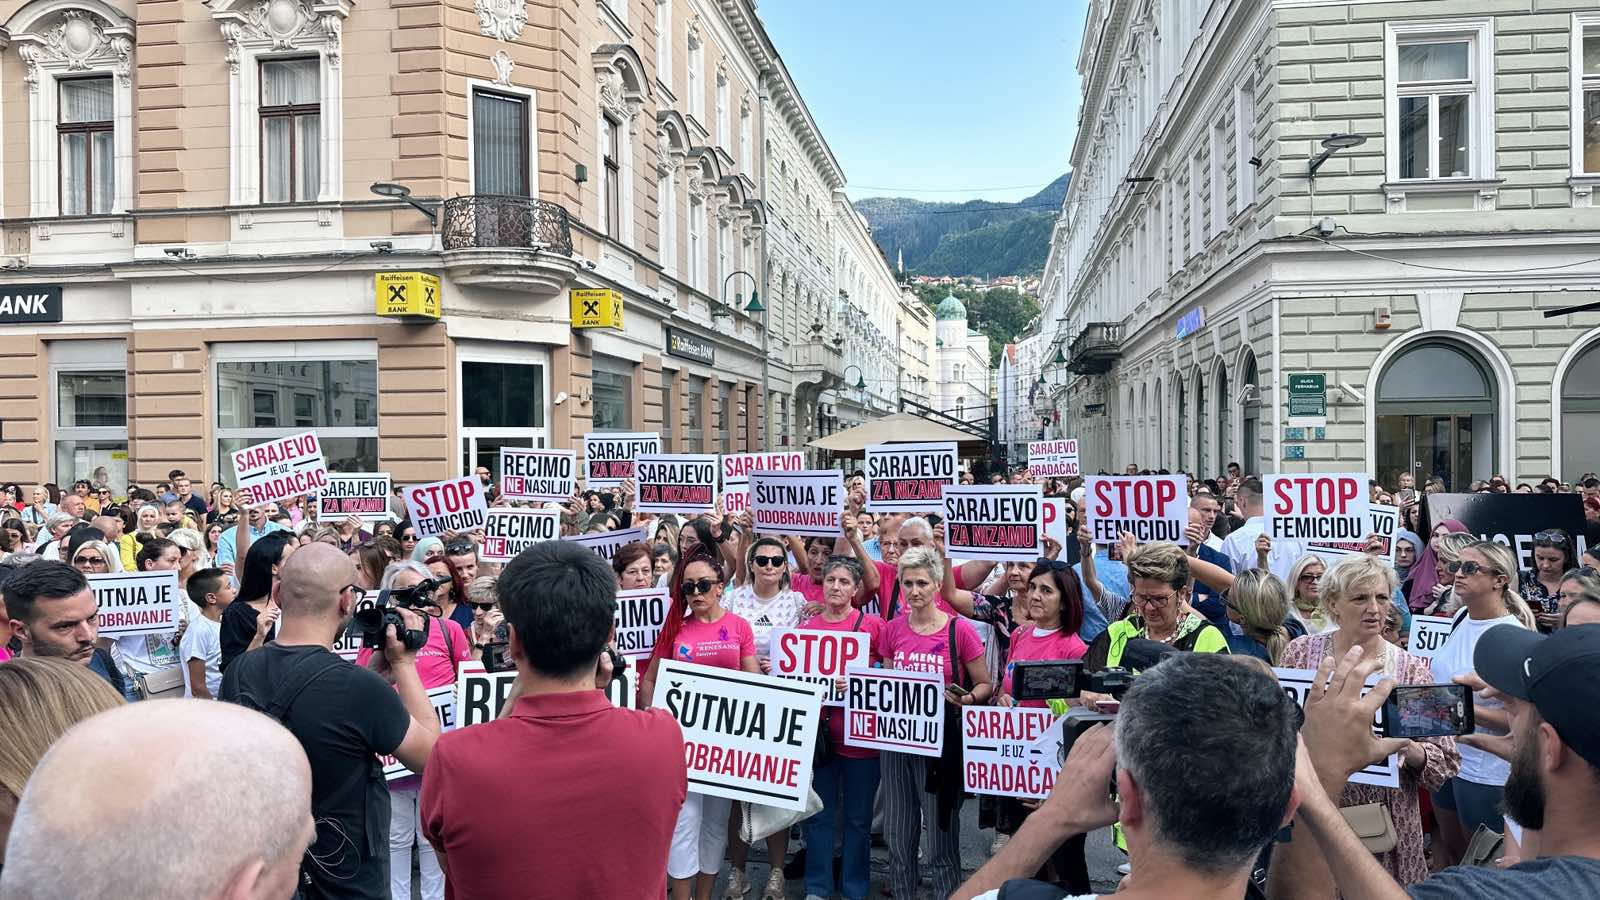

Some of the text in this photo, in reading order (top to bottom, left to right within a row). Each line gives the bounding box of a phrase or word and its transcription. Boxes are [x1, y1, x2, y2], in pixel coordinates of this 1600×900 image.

[235, 435, 317, 472] SARAJEVO
[587, 441, 657, 461] SARAJEVO
[1029, 440, 1076, 456] SARAJEVO
[270, 463, 290, 477] JE UZ
[503, 455, 571, 479] RECIMO
[591, 462, 607, 477] ZA
[637, 464, 714, 484] SARAJEVO
[868, 453, 953, 478] SARAJEVO
[1029, 460, 1078, 476] GRADAČAC
[505, 477, 571, 496] NE NASILJU
[642, 486, 659, 502] ZA
[661, 486, 711, 504] NIZAMU
[756, 480, 815, 506] ŠUTNJA
[820, 485, 837, 506] JE
[873, 481, 892, 499] ZA
[1274, 477, 1358, 516] STOP
[324, 498, 384, 513] ZA NIZAMU
[412, 480, 475, 518] STOP
[946, 497, 1037, 522] SARAJEVO
[1094, 479, 1177, 518] STOP
[418, 508, 484, 536] FEMICIDU
[486, 514, 554, 539] RECIMO
[757, 509, 838, 527] ODOBRAVANJE
[1273, 516, 1361, 539] FEMICIDU
[951, 525, 1034, 547] ZA NIZAMU
[1094, 519, 1180, 541] FEMICIDU
[484, 537, 505, 554] NE
[153, 584, 171, 604] JE
[779, 633, 859, 676] STOP
[908, 651, 945, 665] MENE
[850, 677, 937, 718] RECIMO
[666, 681, 766, 741] ŠUTNJA
[773, 705, 807, 747] JE
[853, 713, 938, 745] NE NASILJU
[1000, 744, 1024, 758] JE UZ
[967, 759, 1060, 795] GRADAČA
